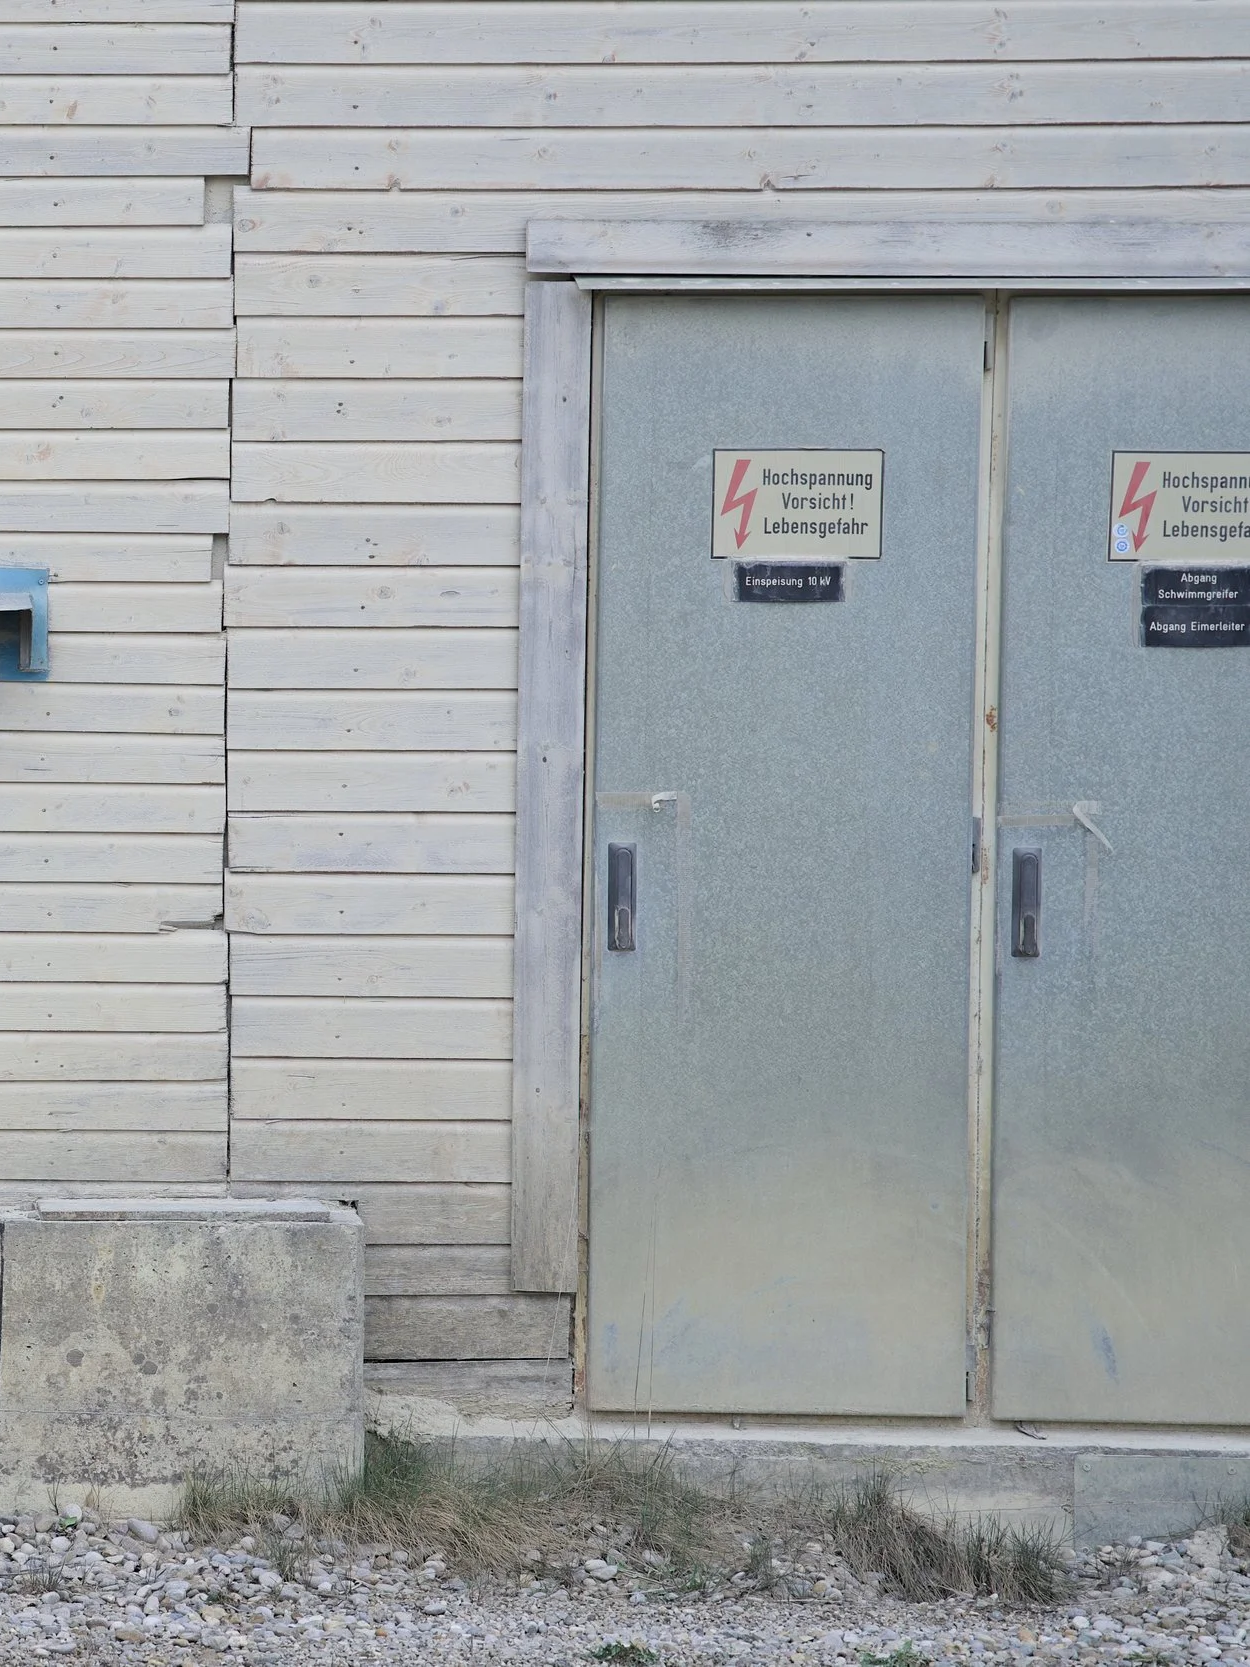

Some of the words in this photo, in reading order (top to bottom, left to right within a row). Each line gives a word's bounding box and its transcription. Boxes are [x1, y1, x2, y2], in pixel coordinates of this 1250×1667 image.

[763, 468, 873, 490] Hochspannung
[1163, 471, 1250, 493] Hochspann
[782, 492, 854, 510] Vorsicht!
[1182, 496, 1249, 513] Vorsicht
[764, 517, 868, 539] Lebensgefahr
[745, 576, 803, 588] Einspeisung
[808, 576, 817, 585] 10
[819, 576, 831, 586] kV
[1180, 573, 1217, 584] Abgang
[1158, 589, 1238, 600] Schwimmgreifer
[1149, 621, 1186, 633] Abgang
[1191, 621, 1246, 632] Eimerleiter
